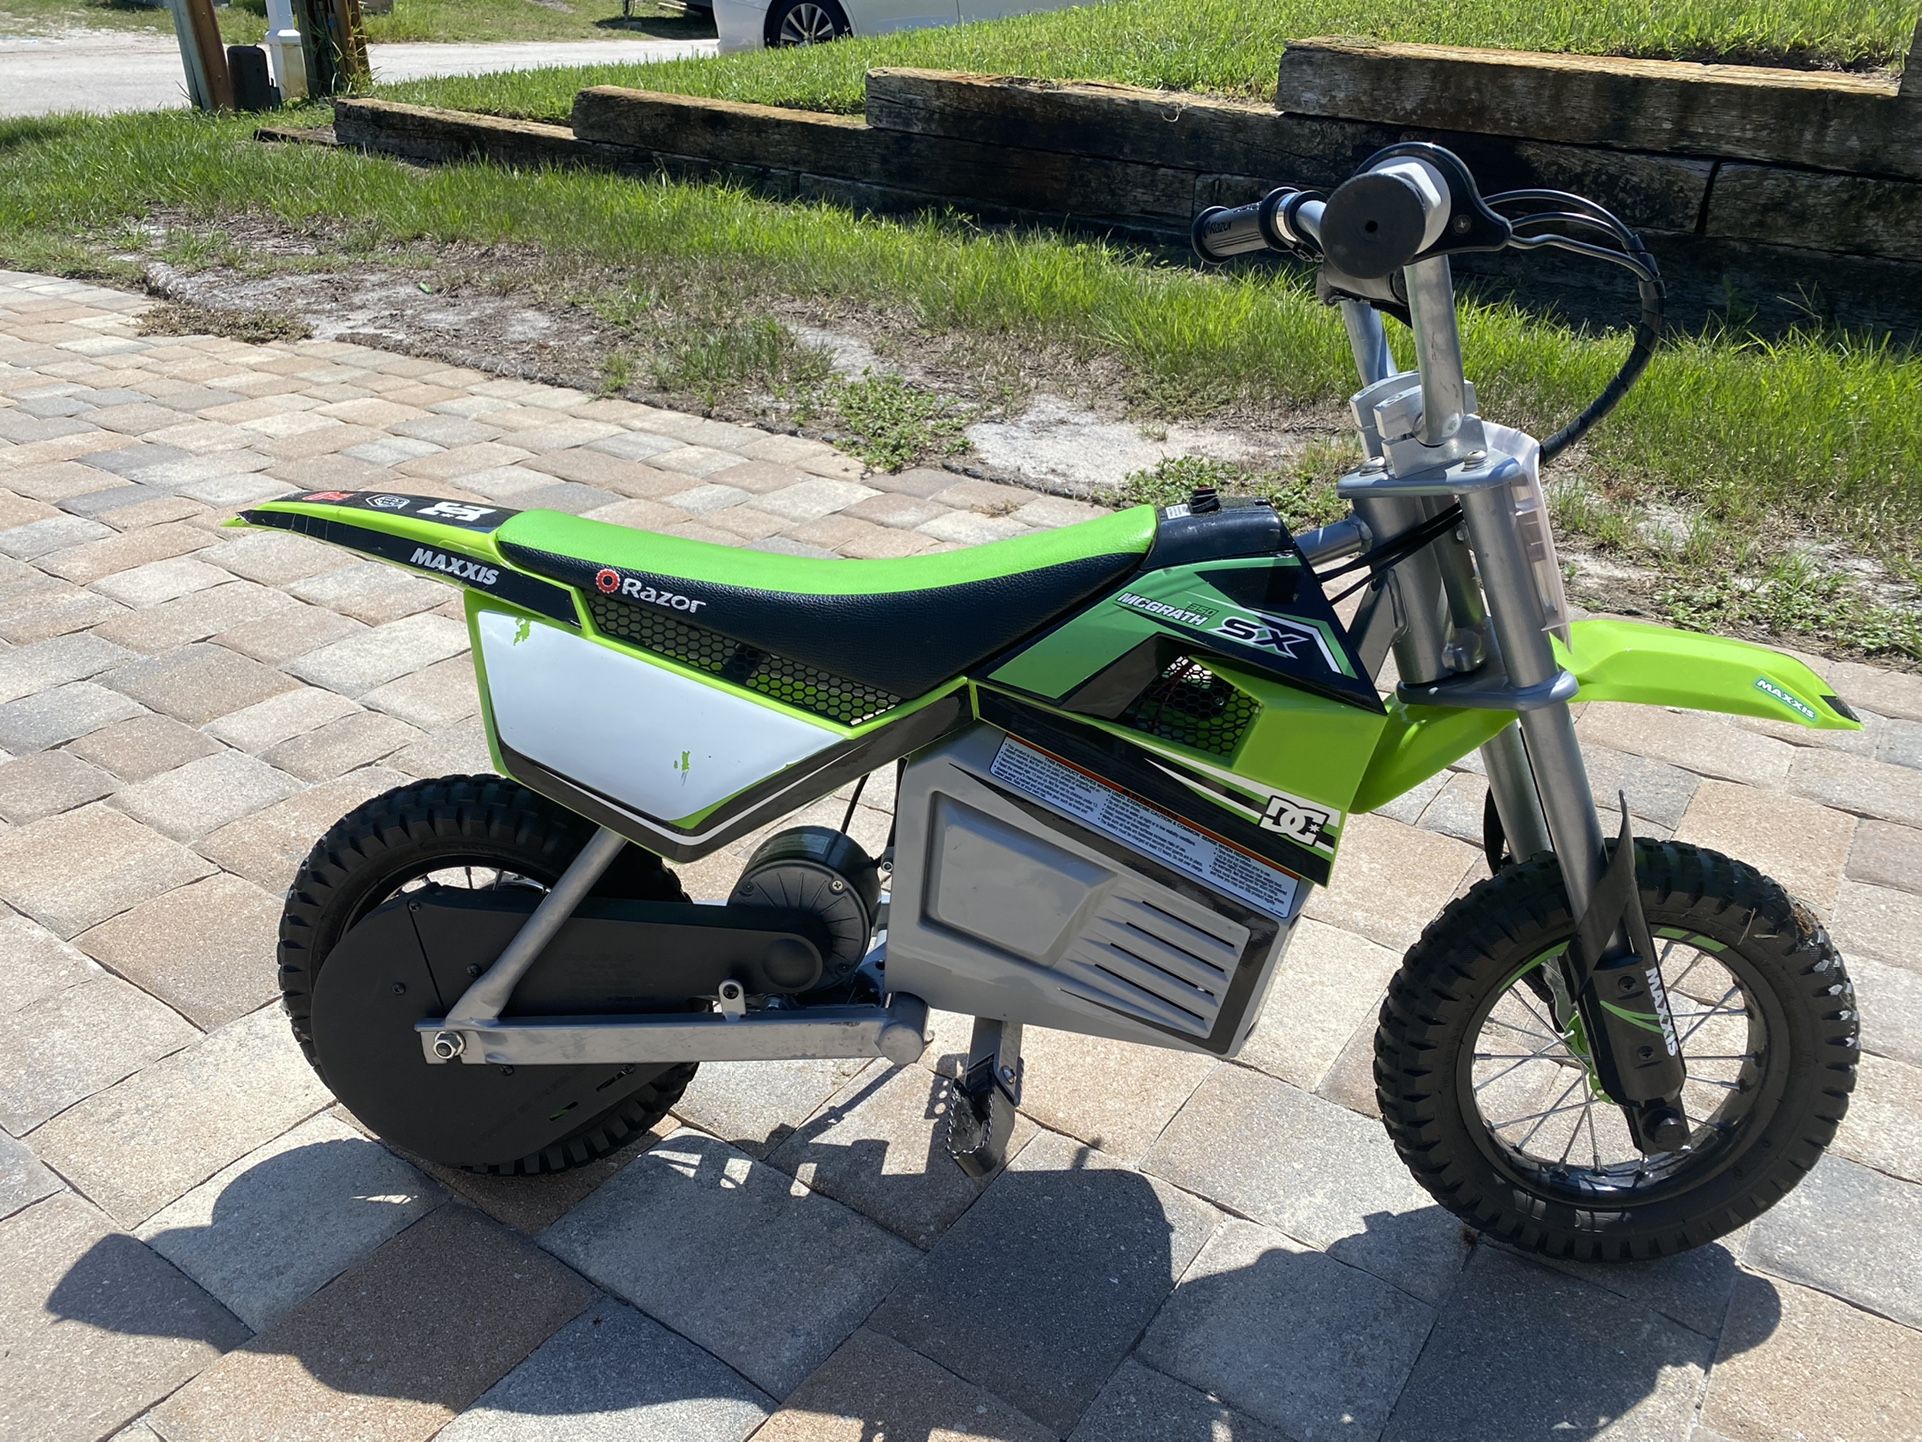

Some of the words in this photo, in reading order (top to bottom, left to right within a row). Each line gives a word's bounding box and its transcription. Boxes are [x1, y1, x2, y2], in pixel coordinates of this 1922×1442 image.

[409, 547, 500, 586] MAXXIS
[621, 578, 707, 614] Razor
[1116, 591, 1209, 627] MCGRATH
[1207, 616, 1309, 659] SX
[1757, 679, 1816, 719] MAXXIS
[1258, 795, 1330, 847] DC
[1645, 966, 1679, 1057] MAXXIS
